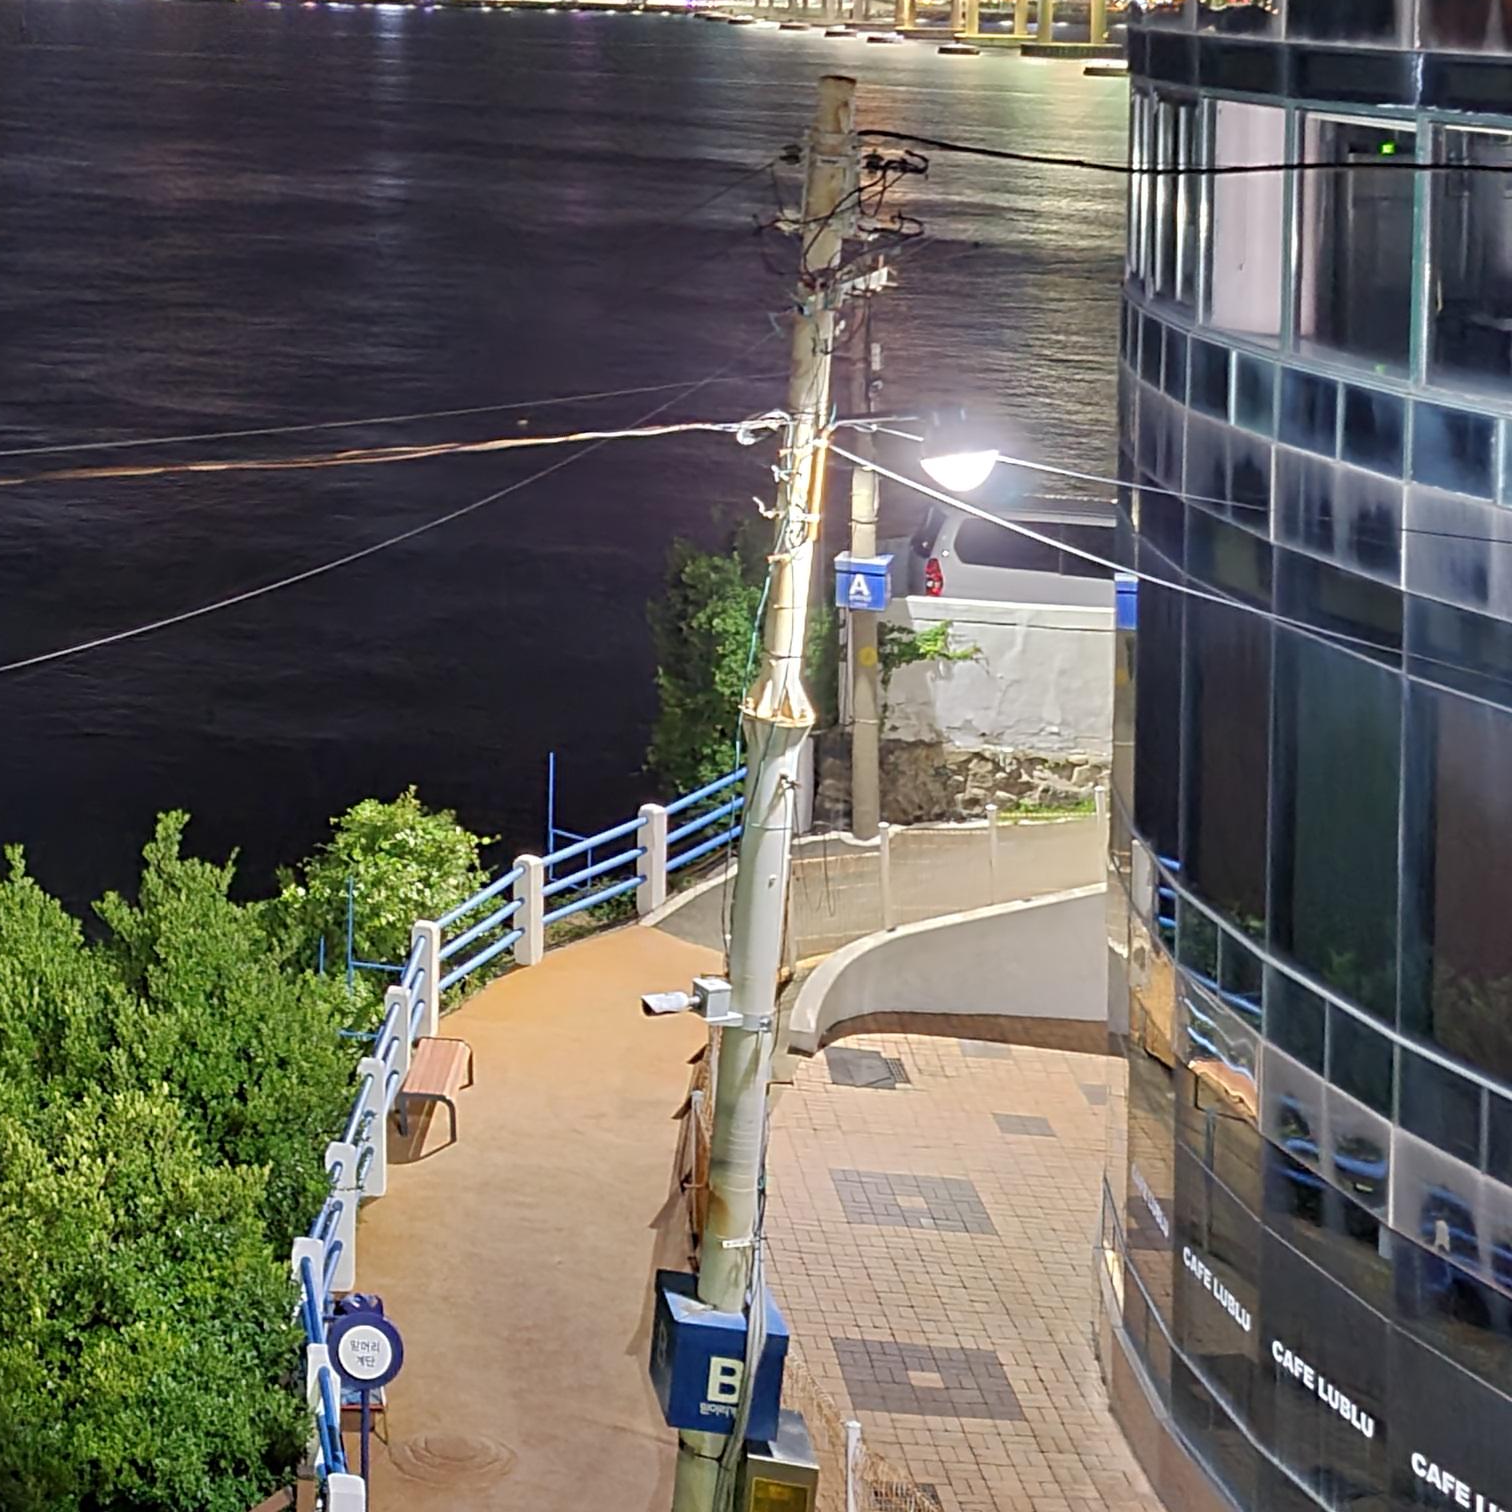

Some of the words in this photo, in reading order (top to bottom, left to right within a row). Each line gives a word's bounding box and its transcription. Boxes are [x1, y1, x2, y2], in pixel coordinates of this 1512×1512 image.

[849, 573, 871, 595] A
[1183, 1246, 1213, 1291] CAFE
[1213, 1277, 1252, 1332] LUBLU
[707, 1356, 744, 1404] B
[1271, 1340, 1315, 1390] CAFE
[1317, 1376, 1374, 1438] LUBLU
[1411, 1452, 1471, 1509] CAFE
